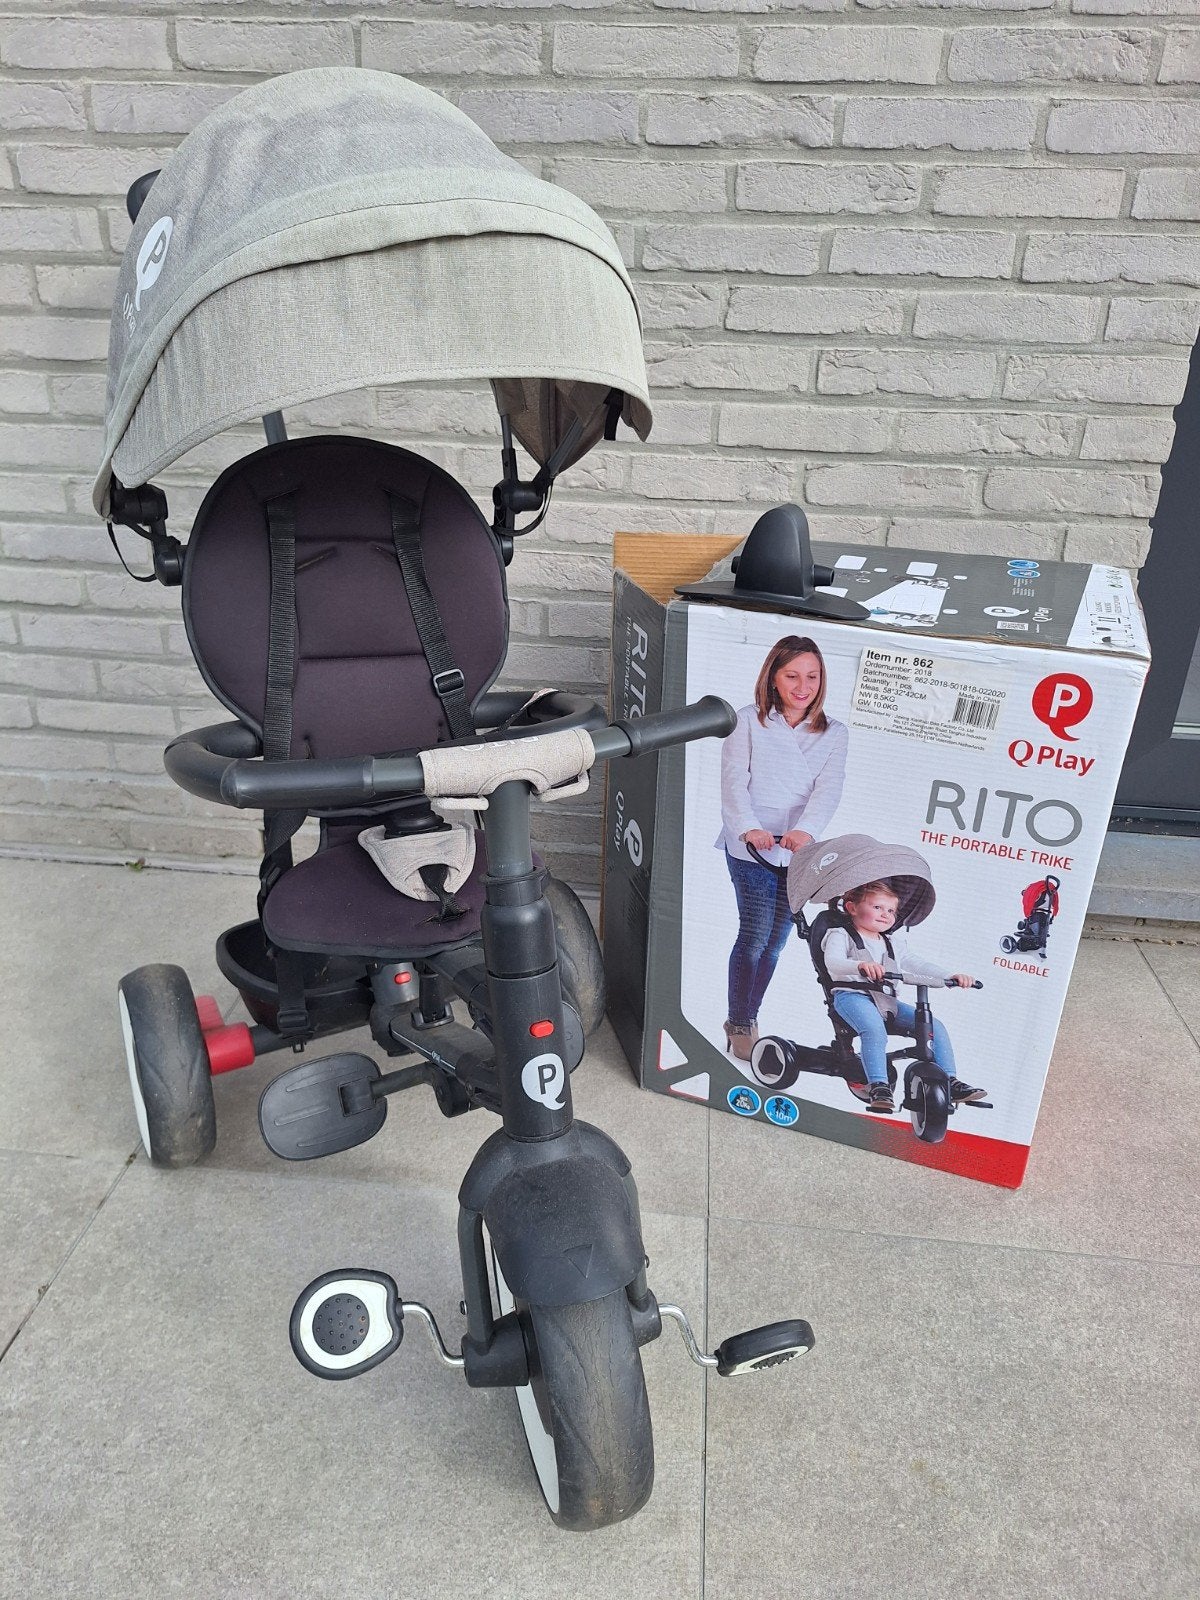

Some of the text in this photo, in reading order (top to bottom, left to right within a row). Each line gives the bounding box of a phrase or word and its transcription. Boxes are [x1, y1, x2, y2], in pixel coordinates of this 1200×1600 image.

[866, 650, 934, 669] Item nr. 862
[914, 668, 932, 677] 2018
[858, 690, 897, 703] NW 8.5KG
[914, 676, 1007, 699] 862-2018-501818-022020
[857, 698, 899, 712] GW 10.0KG
[958, 691, 976, 700] Made
[983, 696, 1002, 704] China
[925, 779, 1083, 847] RITO
[920, 830, 1075, 871] THE PORTABLE TRIKE
[993, 956, 1050, 978] FOLDABLE
